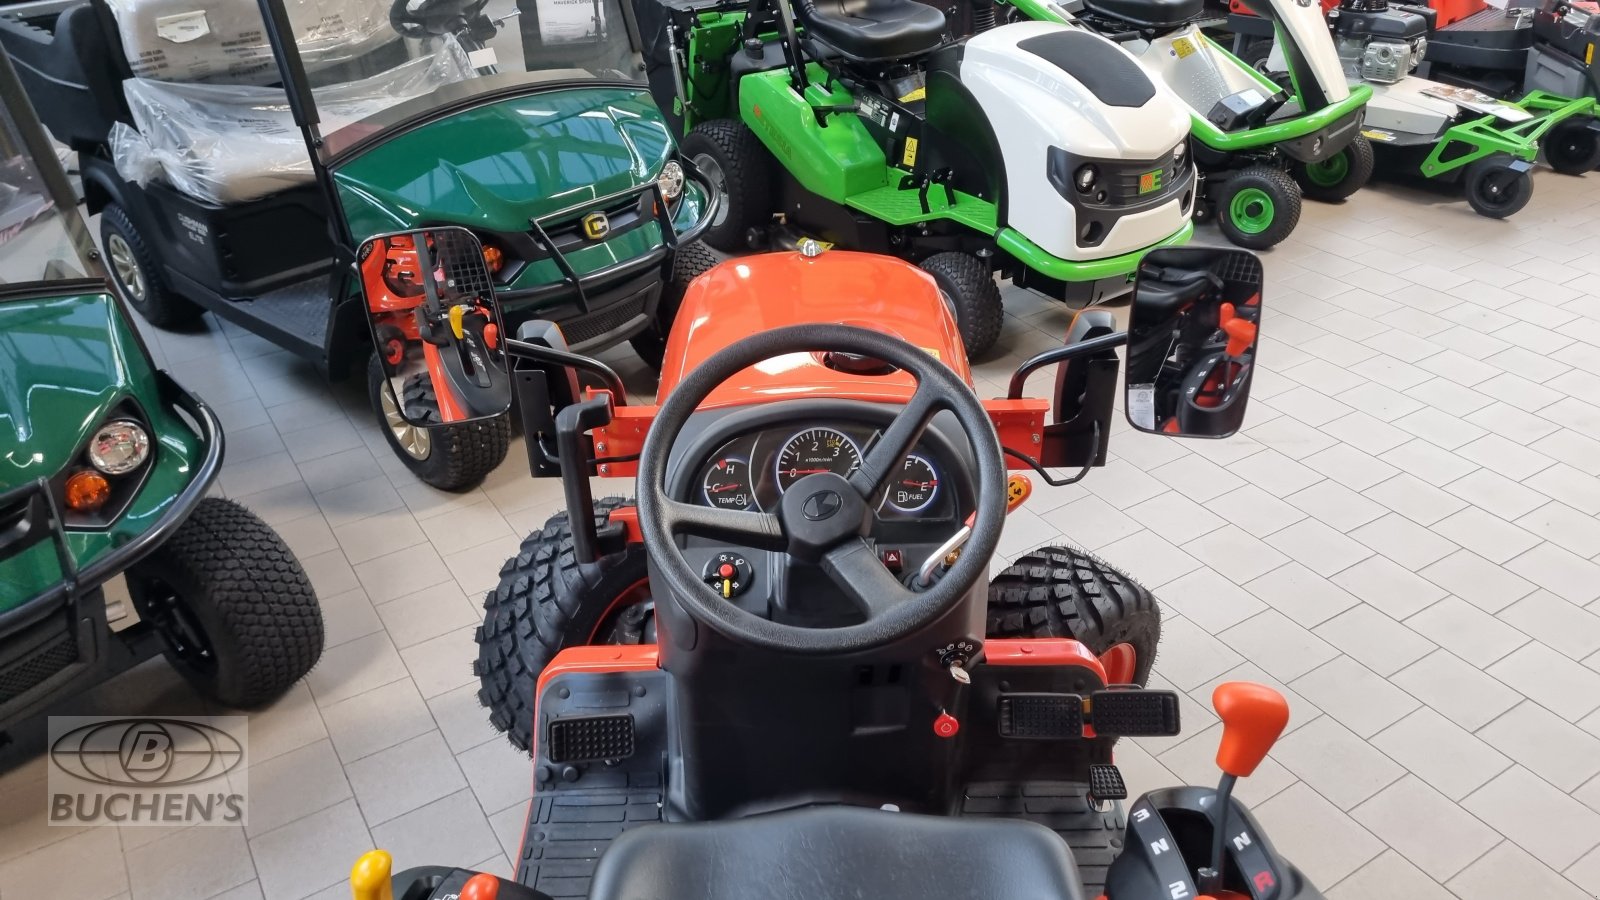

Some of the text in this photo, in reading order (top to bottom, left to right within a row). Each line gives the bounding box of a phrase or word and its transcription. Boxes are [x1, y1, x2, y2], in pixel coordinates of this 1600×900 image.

[811, 441, 818, 451] 2
[795, 452, 801, 461] 1
[833, 447, 840, 457] 3
[726, 465, 735, 474] H
[904, 460, 912, 470] F
[789, 468, 797, 477] 0
[712, 483, 720, 493] C
[920, 481, 929, 491] E
[1133, 808, 1150, 822] 3
[1233, 831, 1251, 851] N
[1150, 838, 1170, 855] N
[1253, 870, 1275, 892] R
[1168, 880, 1189, 900] 2
